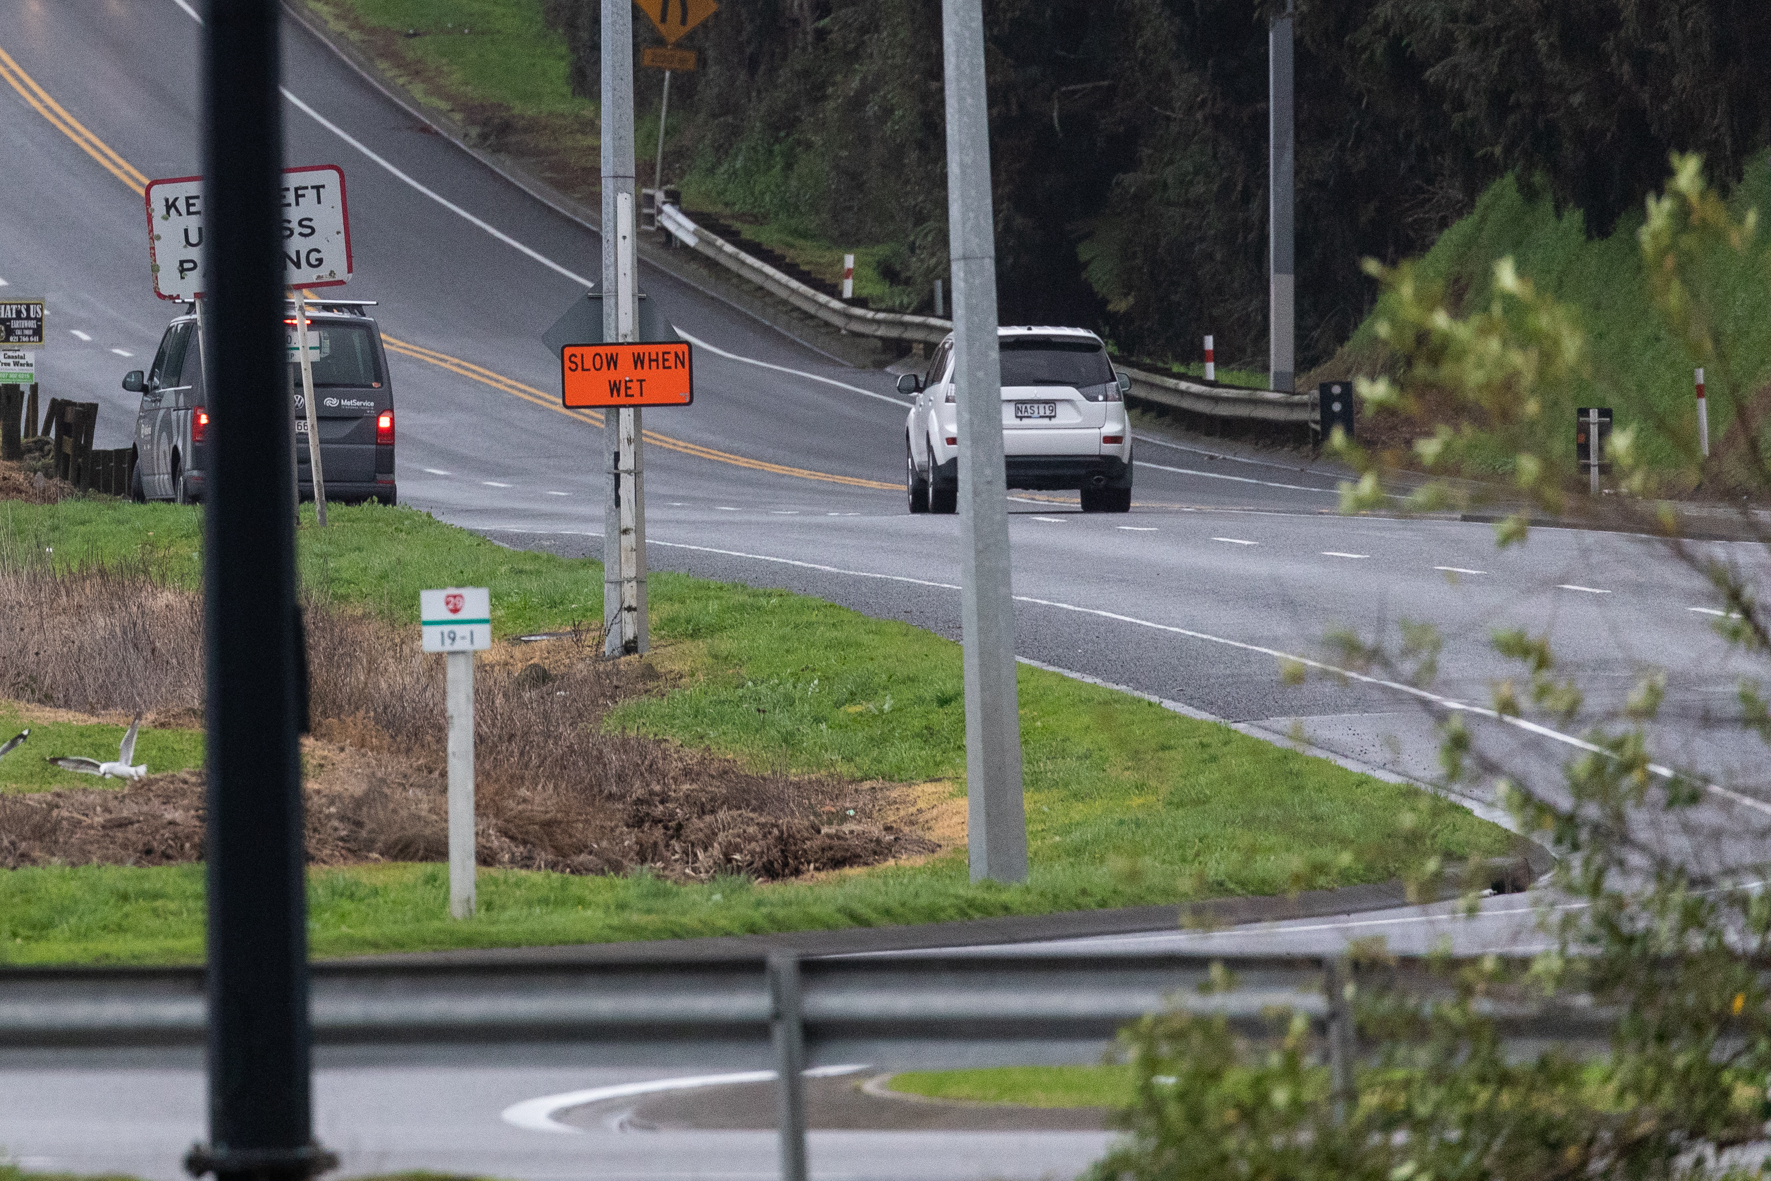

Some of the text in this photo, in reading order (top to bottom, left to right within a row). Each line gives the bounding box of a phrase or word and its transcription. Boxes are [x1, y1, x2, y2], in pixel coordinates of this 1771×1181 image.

[30, 304, 42, 318] US
[568, 351, 686, 372] SLOW WHEN
[608, 379, 646, 398] WET
[341, 398, 375, 407] MetService
[1017, 405, 1054, 415] NAS119
[440, 629, 474, 647] 19-1
